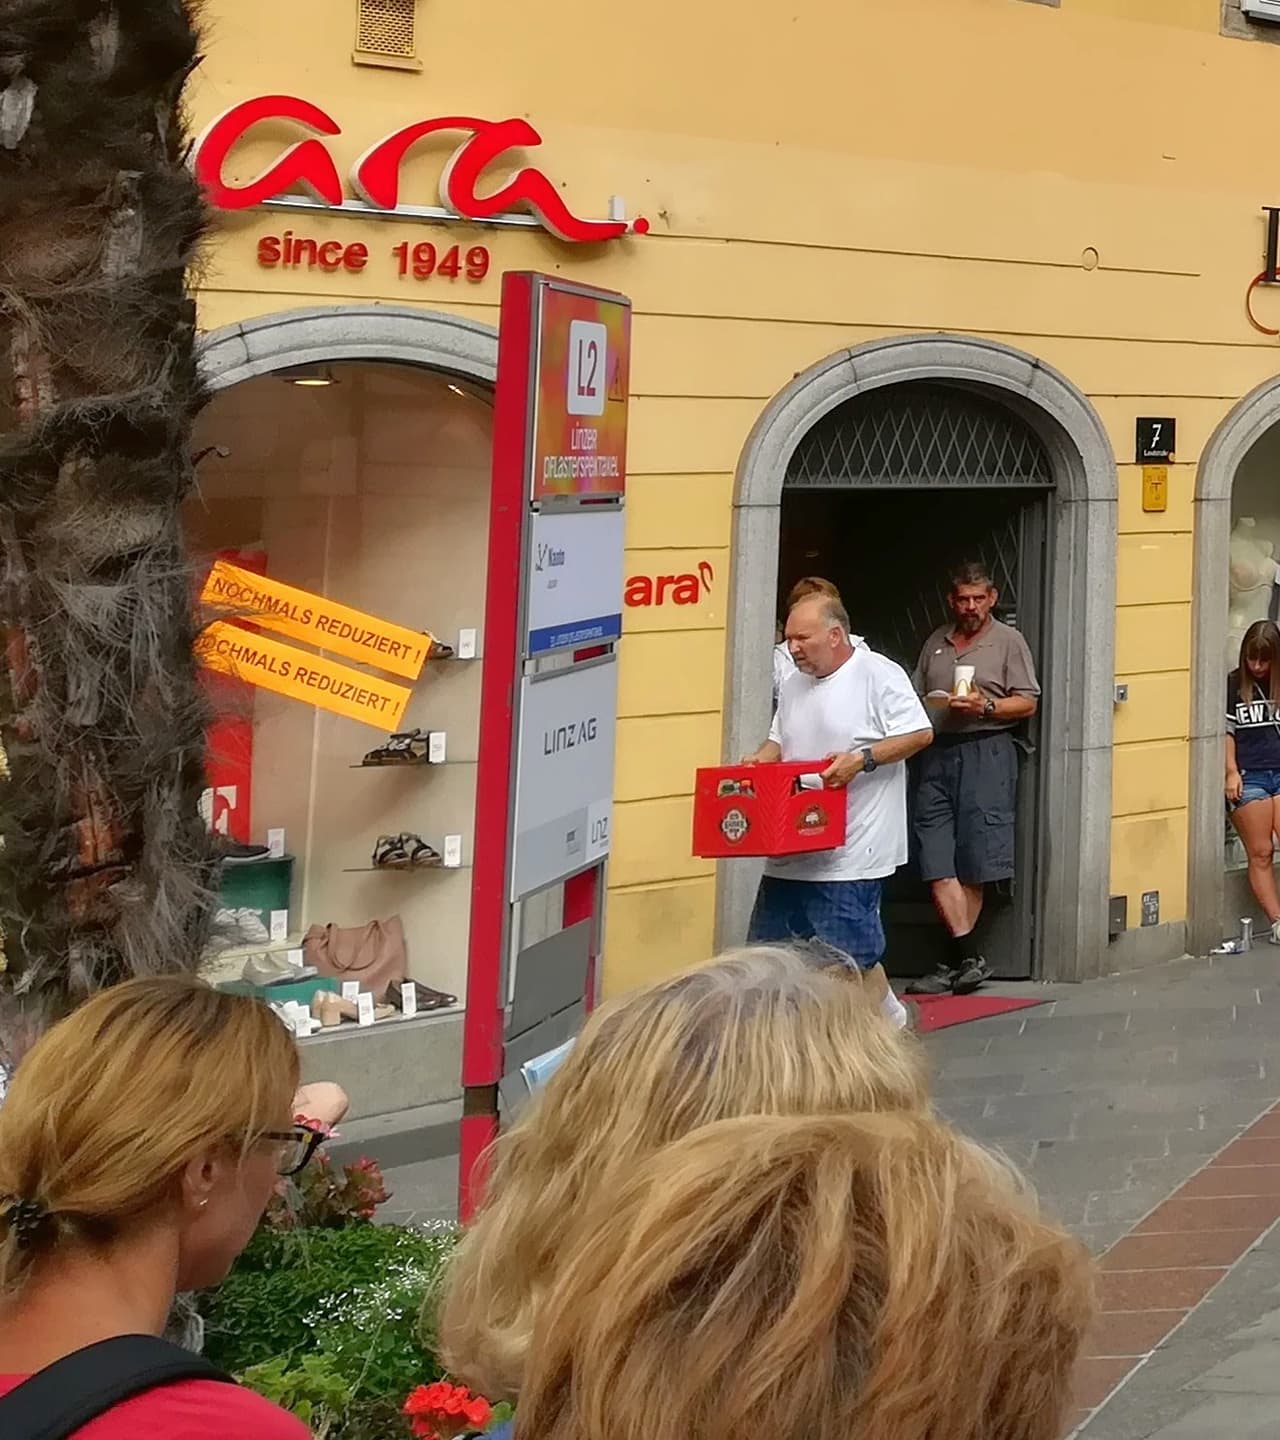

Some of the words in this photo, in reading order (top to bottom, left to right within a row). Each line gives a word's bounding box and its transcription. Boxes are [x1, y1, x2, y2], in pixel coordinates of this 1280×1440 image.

[257, 231, 369, 270] since
[392, 241, 490, 282] 1949
[577, 339, 598, 397] L2
[1150, 423, 1163, 449] 7
[624, 567, 700, 607] ara
[213, 577, 314, 625] NOCHMALS
[315, 614, 413, 660] REDUZIERT
[293, 667, 392, 713] REDUZIERT
[577, 718, 597, 743] AG
